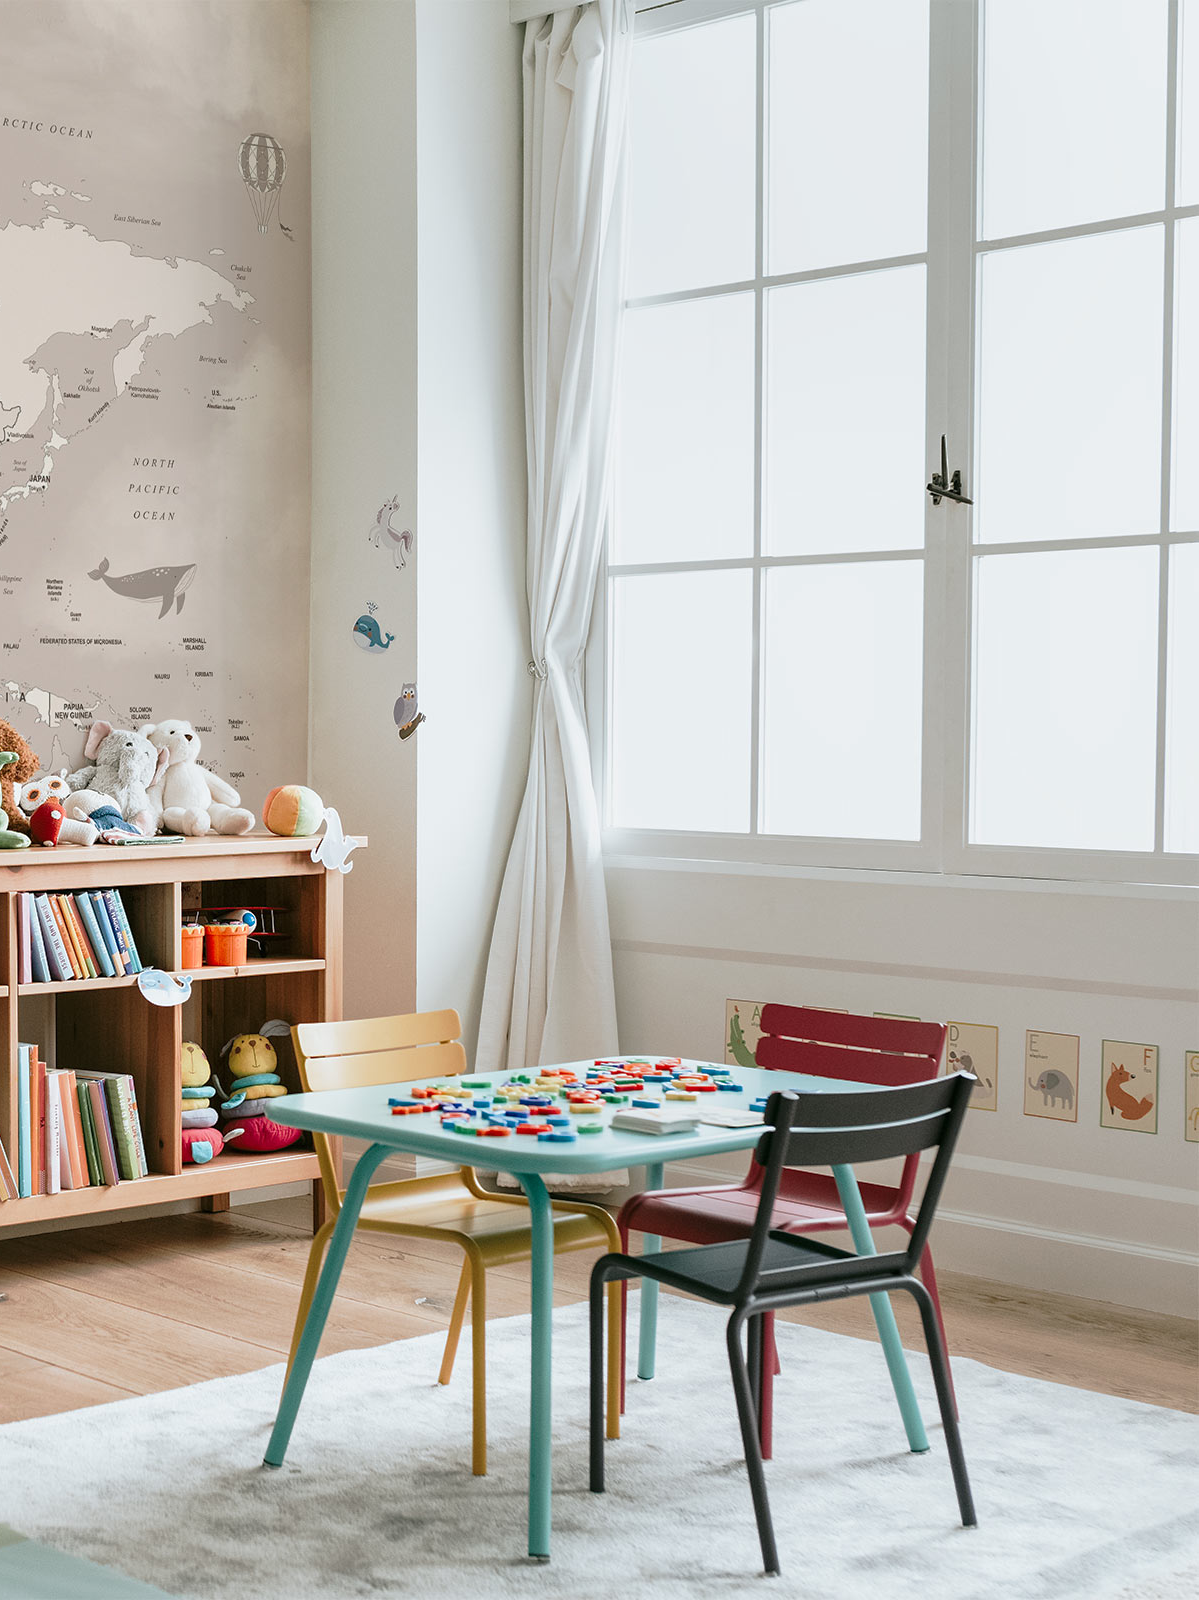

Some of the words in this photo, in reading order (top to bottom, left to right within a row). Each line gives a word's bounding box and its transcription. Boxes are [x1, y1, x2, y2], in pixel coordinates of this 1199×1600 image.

[49, 124, 93, 139] OCEAN
[133, 458, 175, 468] NORTH
[29, 475, 51, 483] JAPAN
[129, 484, 180, 494] PACIFIC
[133, 511, 175, 520] OCEAN
[111, 912, 119, 931] MAGIC
[41, 905, 51, 923] JENNY
[58, 952, 67, 970] HORSE
[752, 1006, 760, 1021] A
[950, 1025, 959, 1041] D
[1030, 1035, 1039, 1052] E
[1144, 1048, 1153, 1065] F
